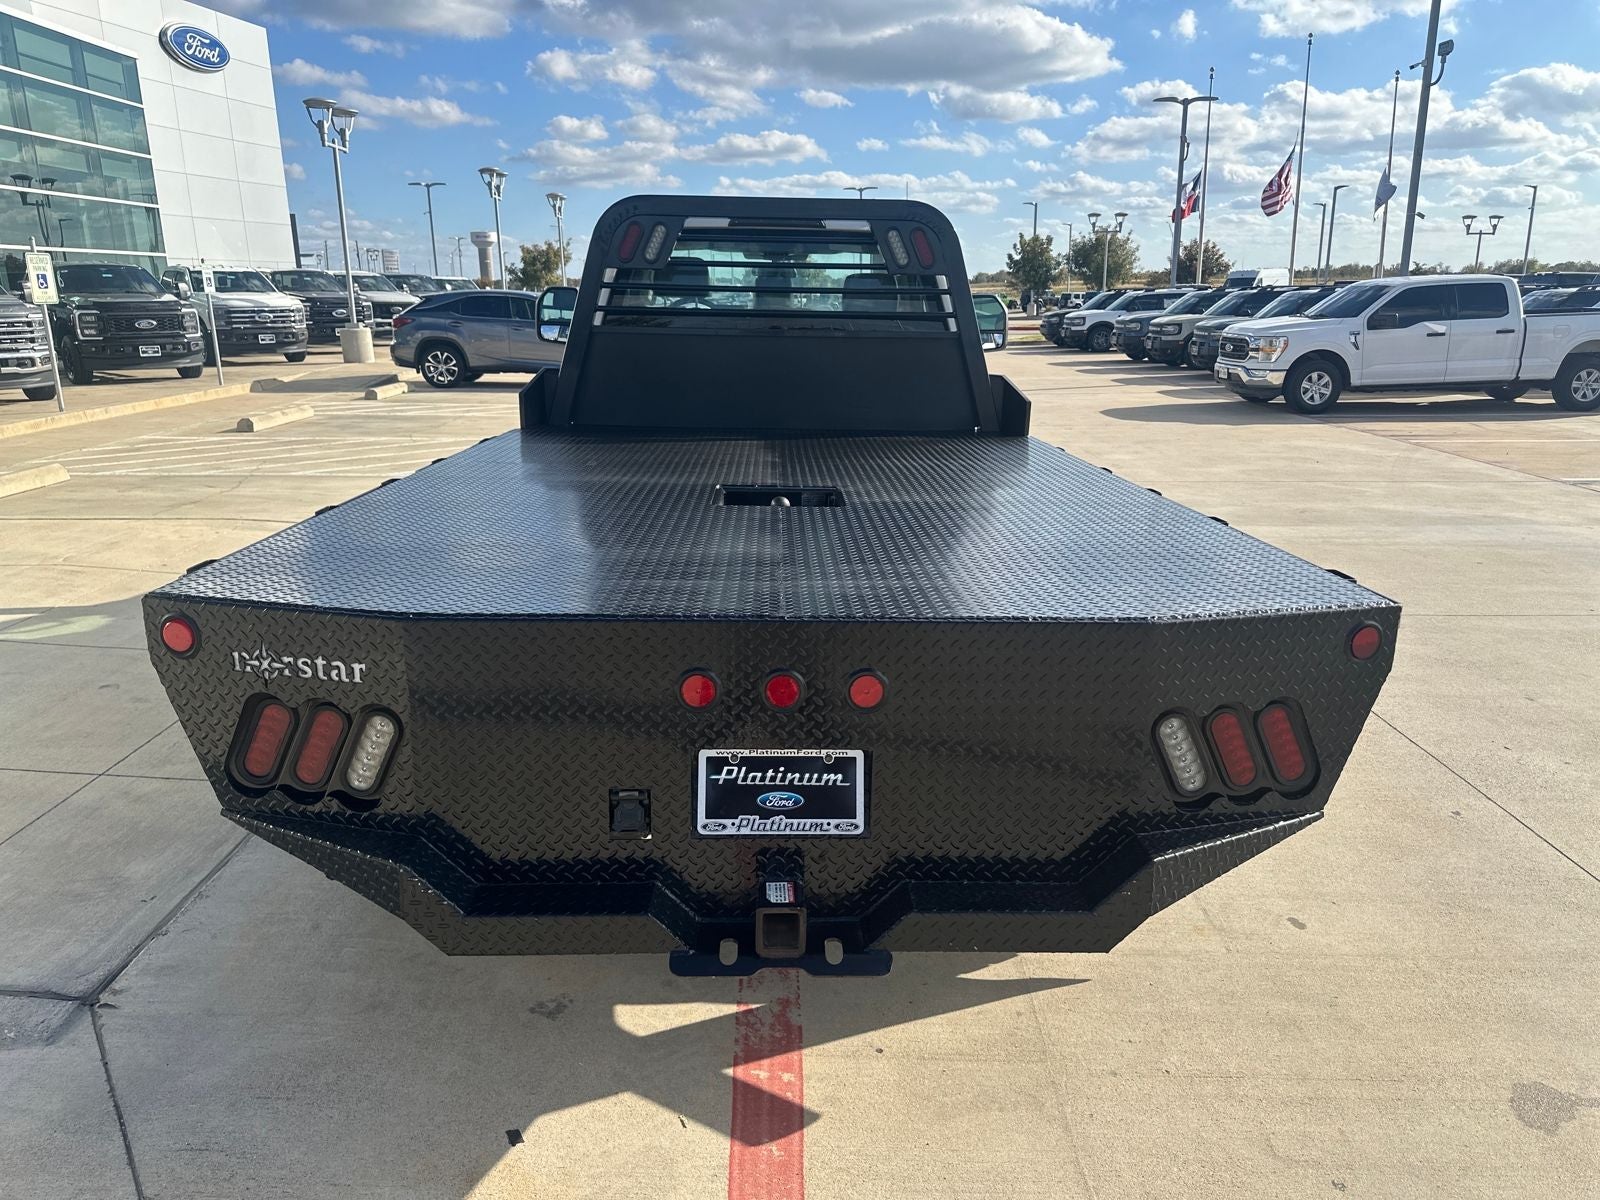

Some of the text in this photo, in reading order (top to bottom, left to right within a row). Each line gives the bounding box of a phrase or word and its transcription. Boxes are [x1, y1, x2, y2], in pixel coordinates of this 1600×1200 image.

[184, 32, 220, 63] Ford
[709, 766, 850, 786] Platinum
[766, 794, 795, 807] Ford
[737, 816, 831, 832] Platinum
